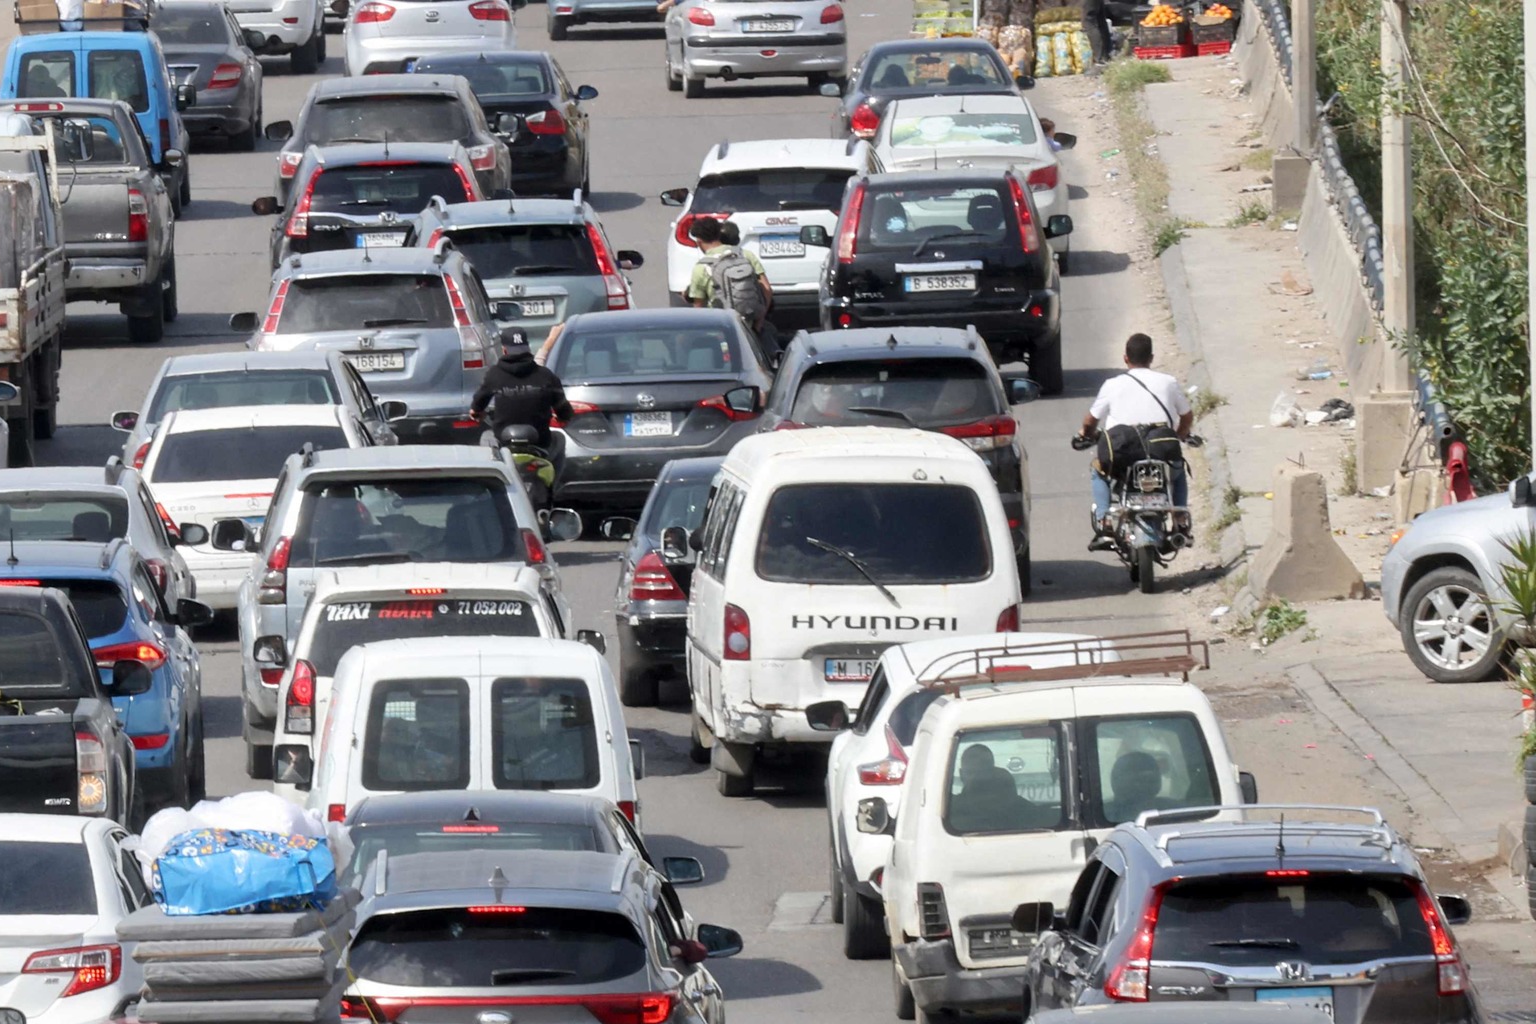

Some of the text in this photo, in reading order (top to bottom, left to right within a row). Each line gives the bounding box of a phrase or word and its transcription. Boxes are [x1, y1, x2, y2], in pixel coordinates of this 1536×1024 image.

[765, 217, 798, 226] GMC
[913, 275, 968, 290] B 538352
[355, 352, 396, 369] 168154
[326, 603, 372, 621] TAXI
[458, 602, 470, 614] 71
[473, 602, 496, 615] 052
[498, 602, 522, 616] 002
[792, 615, 958, 632] HYUNDAI
[837, 661, 847, 676] M
